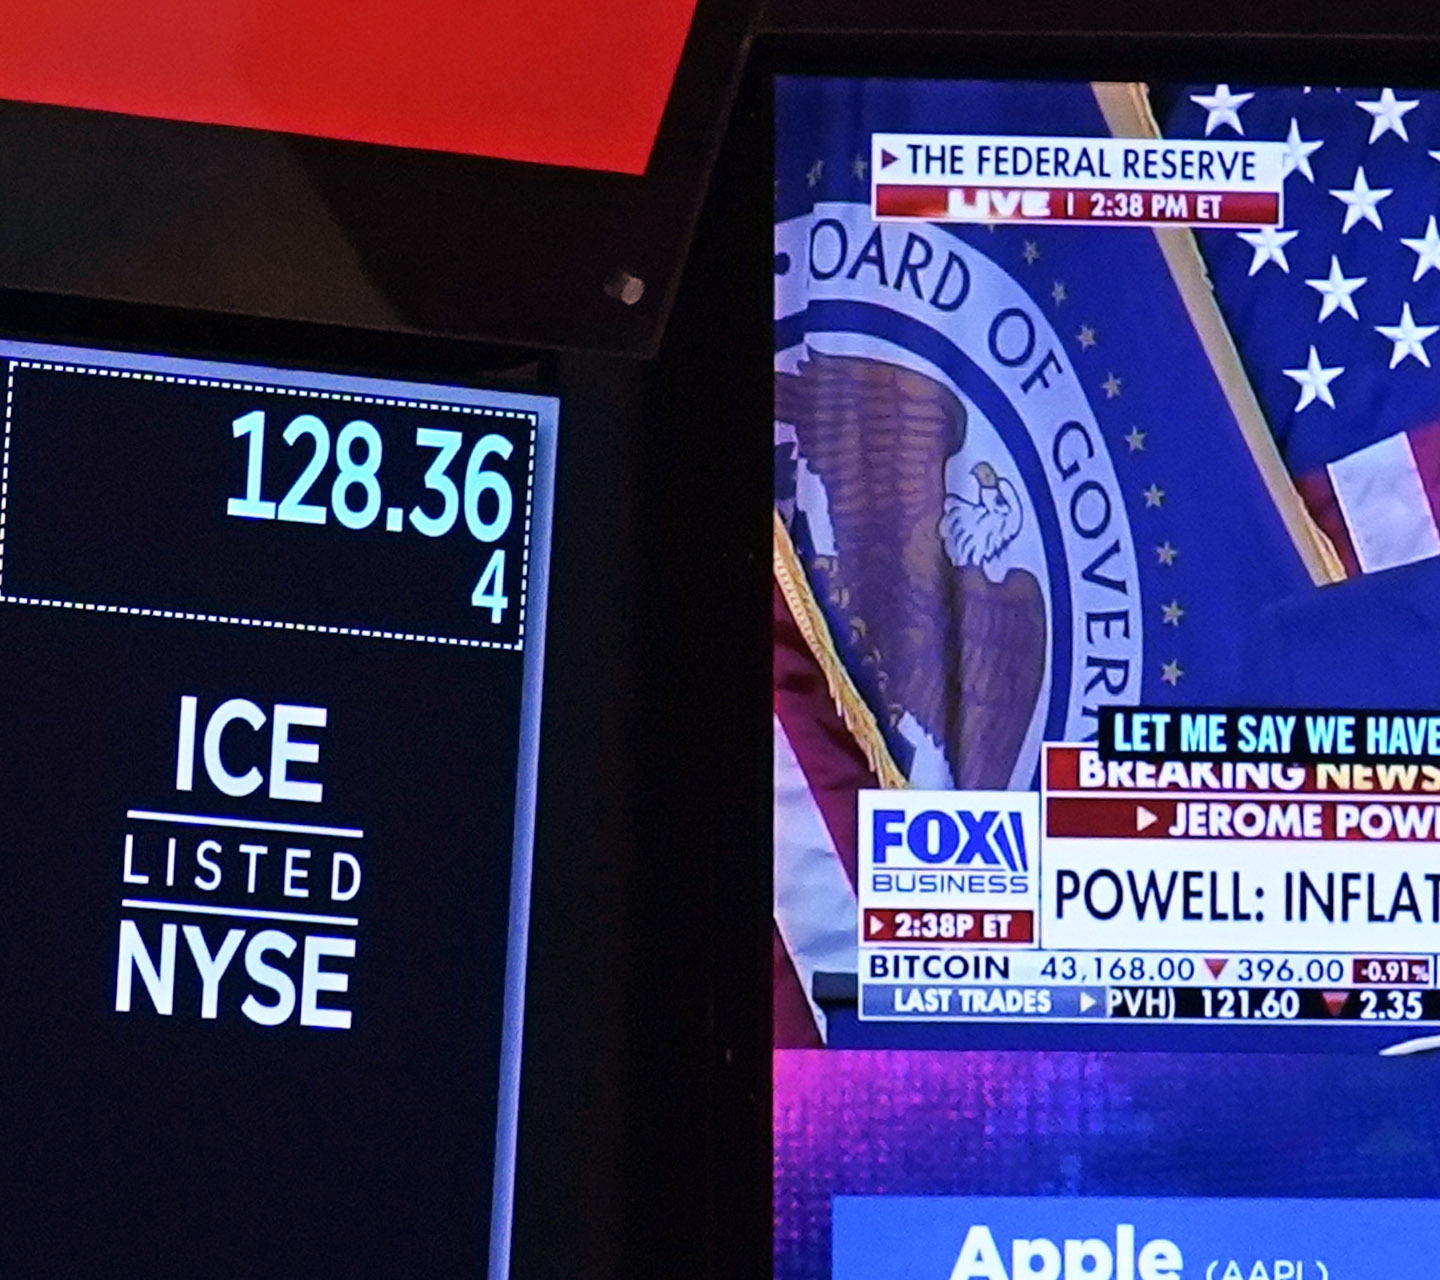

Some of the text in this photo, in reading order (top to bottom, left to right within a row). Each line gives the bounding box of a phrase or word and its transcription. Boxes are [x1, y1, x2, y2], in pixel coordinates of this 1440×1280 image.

[907, 143, 1257, 183] THE FEDERAL RESERVE
[1090, 191, 1223, 219] 2:38 PM ET
[226, 410, 515, 542] 128.36
[470, 549, 509, 624] 4
[175, 694, 328, 804] ICE
[1113, 713, 1171, 752] LET
[1180, 713, 1229, 753] ME
[1237, 714, 1298, 754] SAY
[1306, 715, 1358, 755] WE
[872, 808, 1004, 866] FOX
[1168, 802, 1323, 838] JEROME
[122, 832, 362, 902] LISTED
[871, 874, 1029, 894] BUSINESS
[1055, 868, 1264, 922] POWELL:
[114, 920, 357, 1030] NYSE
[869, 954, 1344, 983] BITCOIN 43,168.00 396.00
